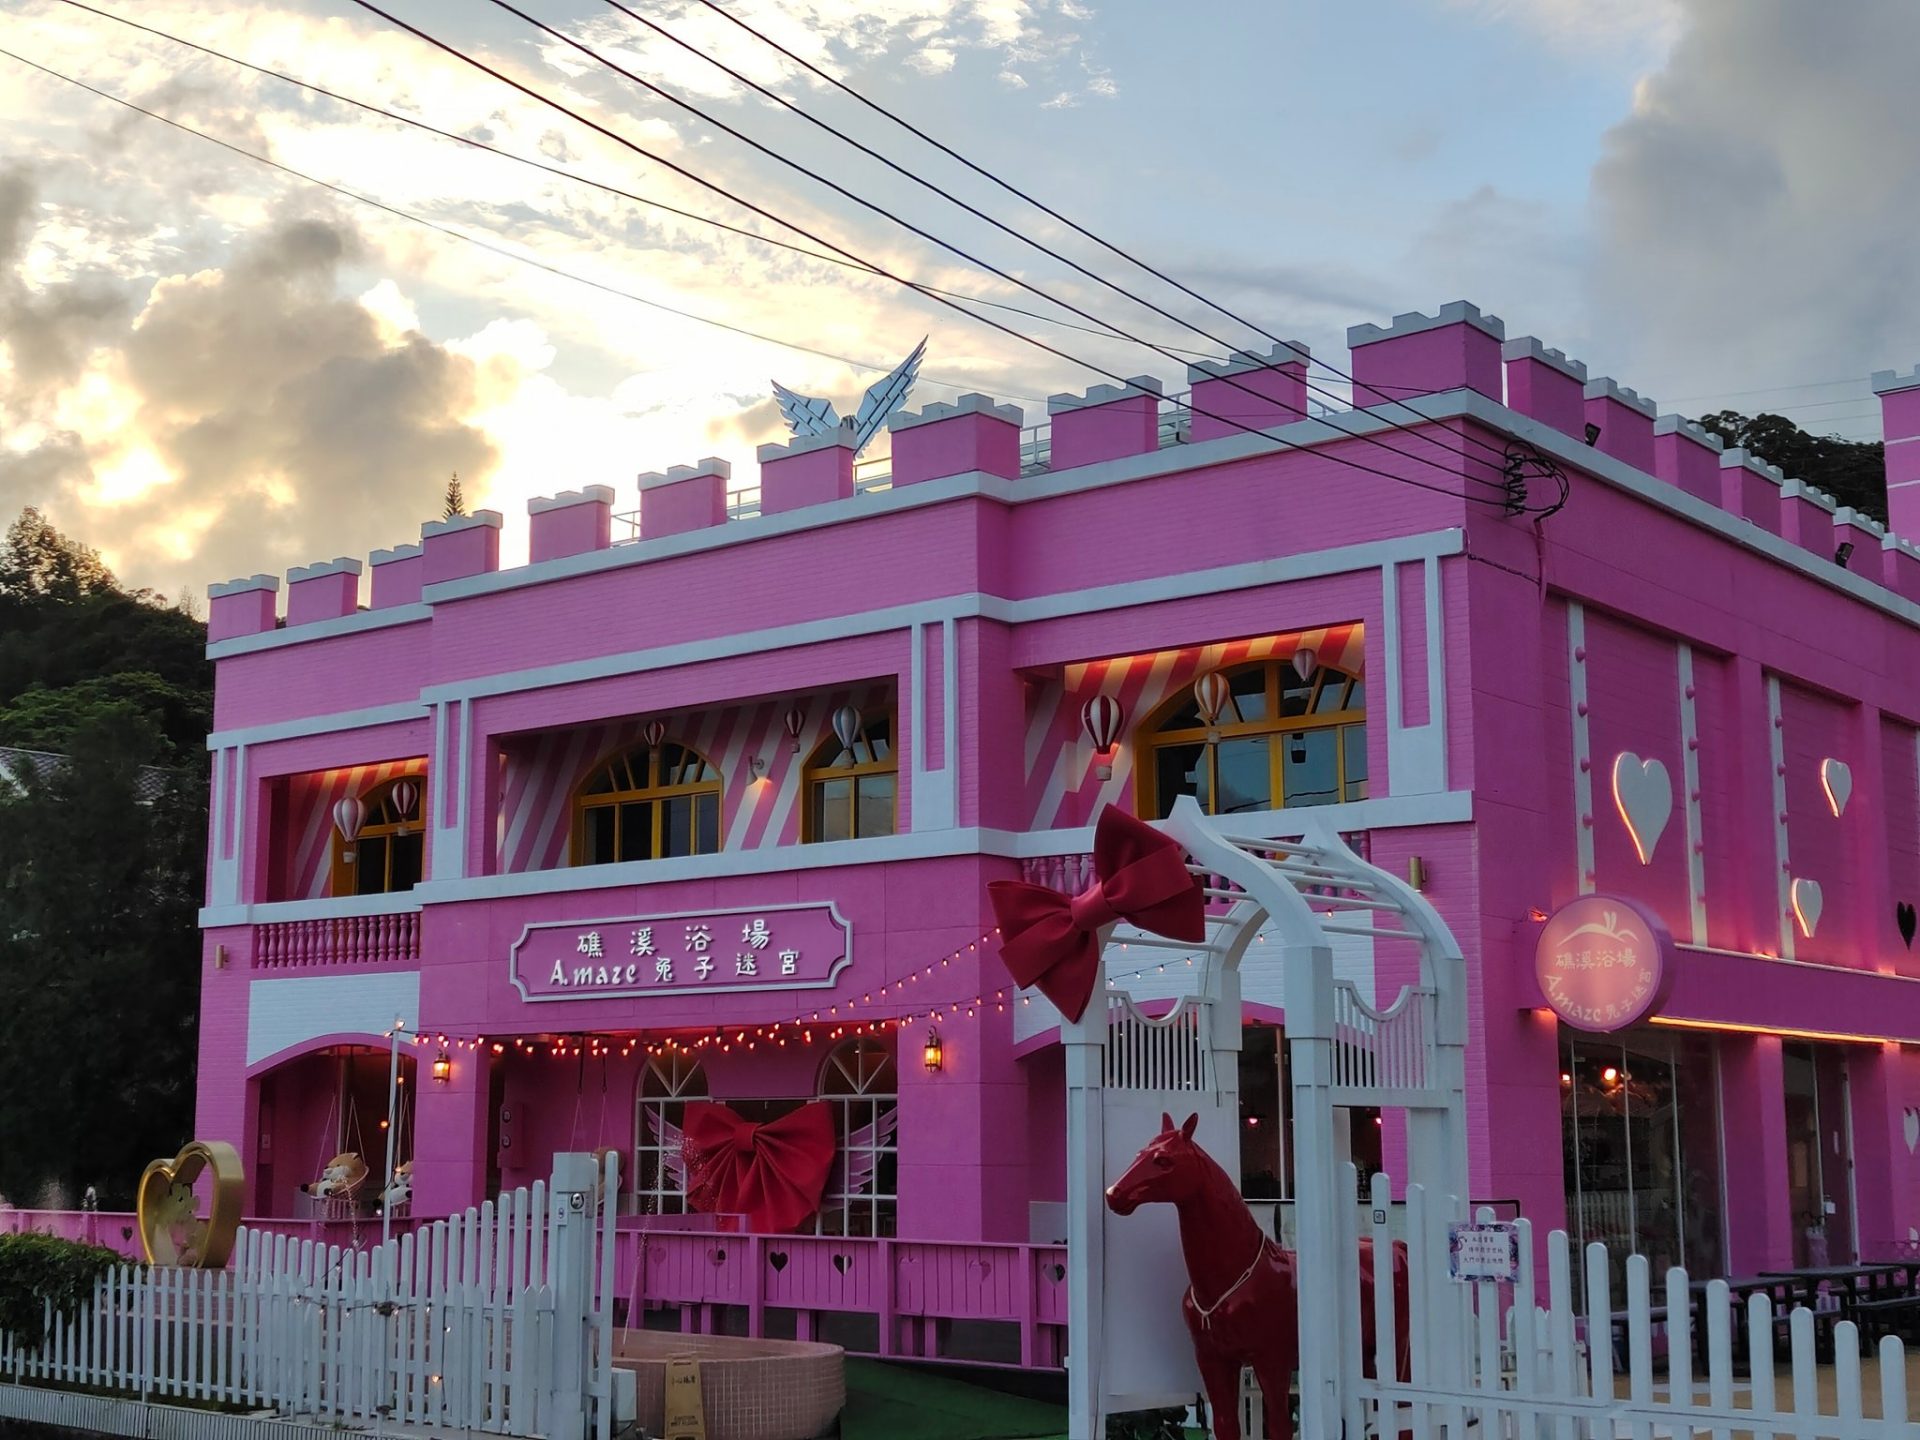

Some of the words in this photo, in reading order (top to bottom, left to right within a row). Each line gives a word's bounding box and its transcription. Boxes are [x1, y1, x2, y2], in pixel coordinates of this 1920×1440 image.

[577, 918, 771, 957] 礁溪浴場
[549, 959, 639, 986] A.maze
[654, 948, 801, 983] 兔子迷宮
[1555, 947, 1637, 970] 礁溪浴場
